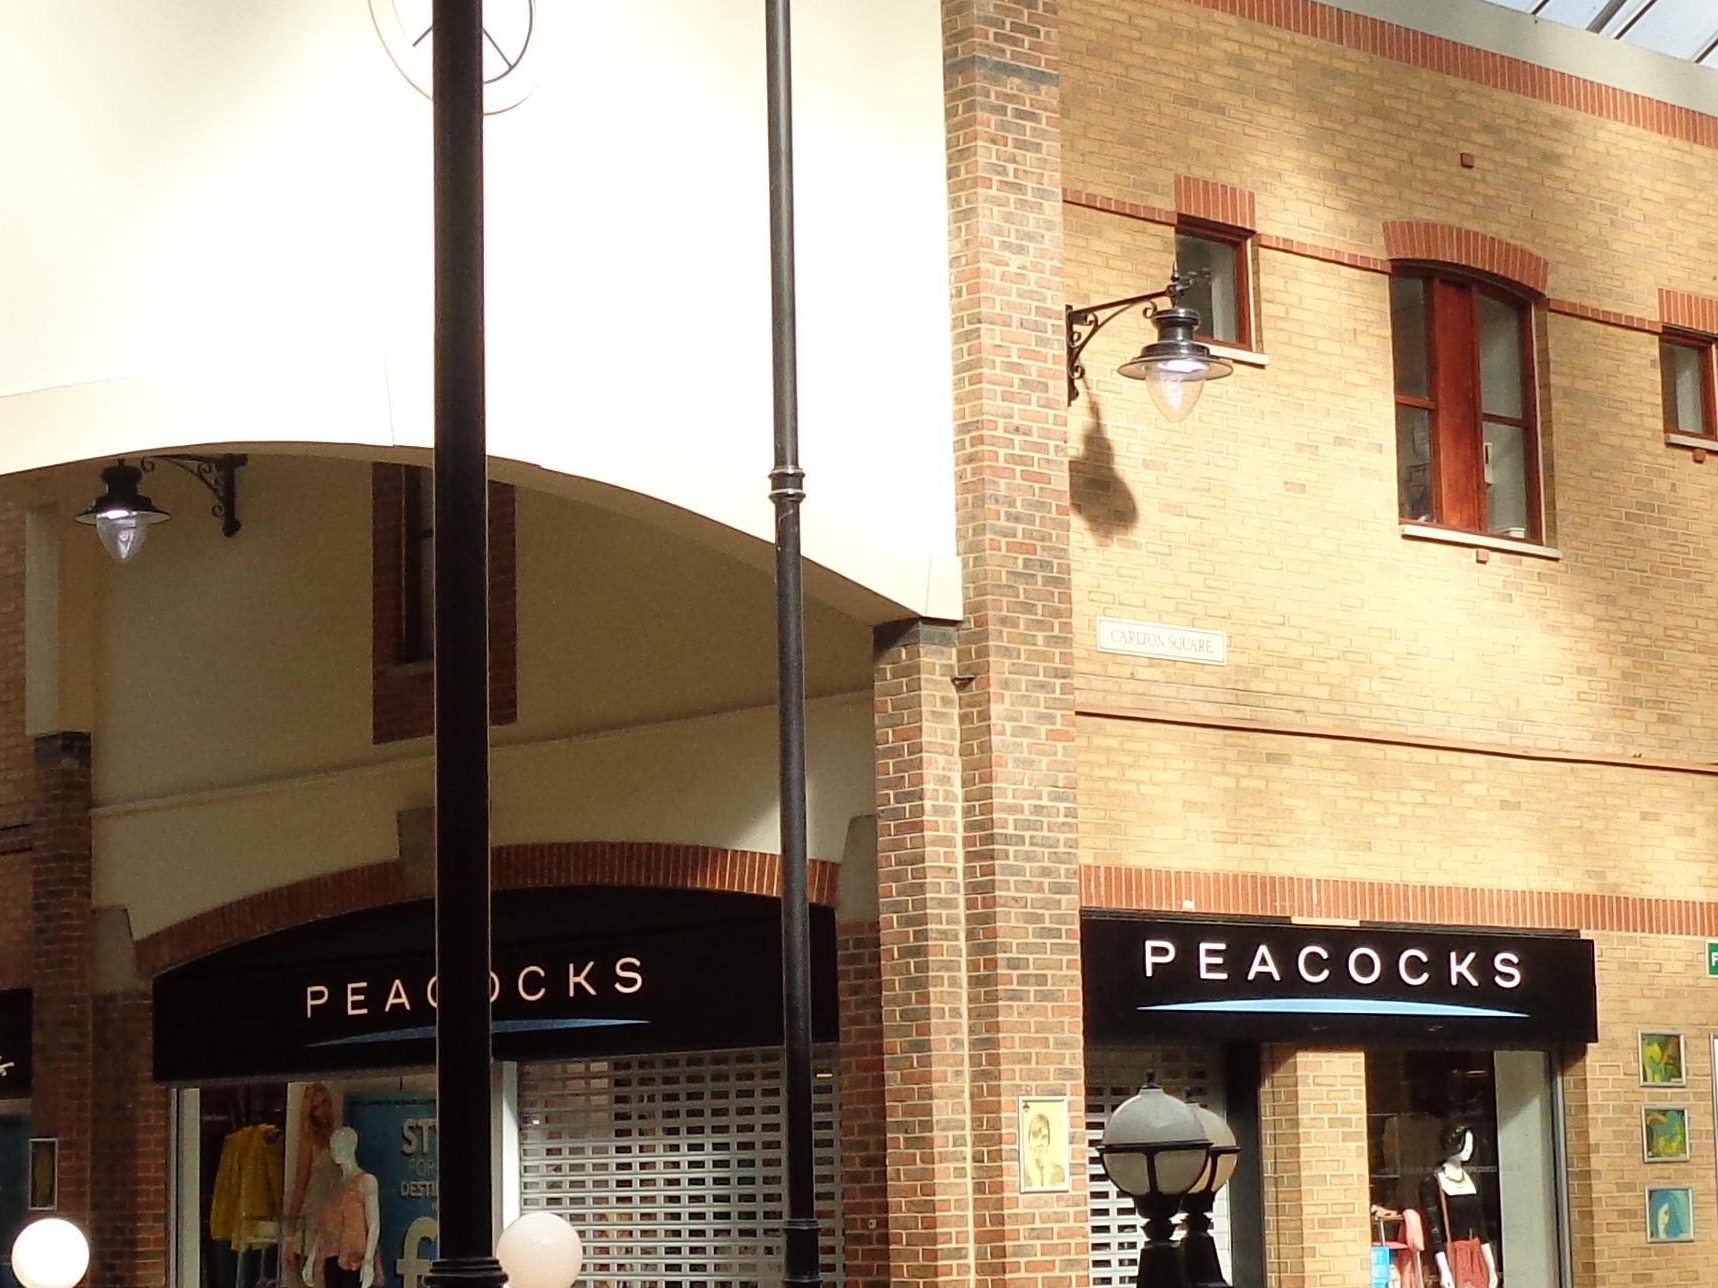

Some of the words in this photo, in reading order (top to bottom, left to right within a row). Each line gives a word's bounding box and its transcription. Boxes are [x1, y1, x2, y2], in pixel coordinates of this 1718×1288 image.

[1110, 628, 1165, 648] CARLTON
[1168, 634, 1214, 654] SQUARE
[1144, 939, 1522, 989] PEACOCKS
